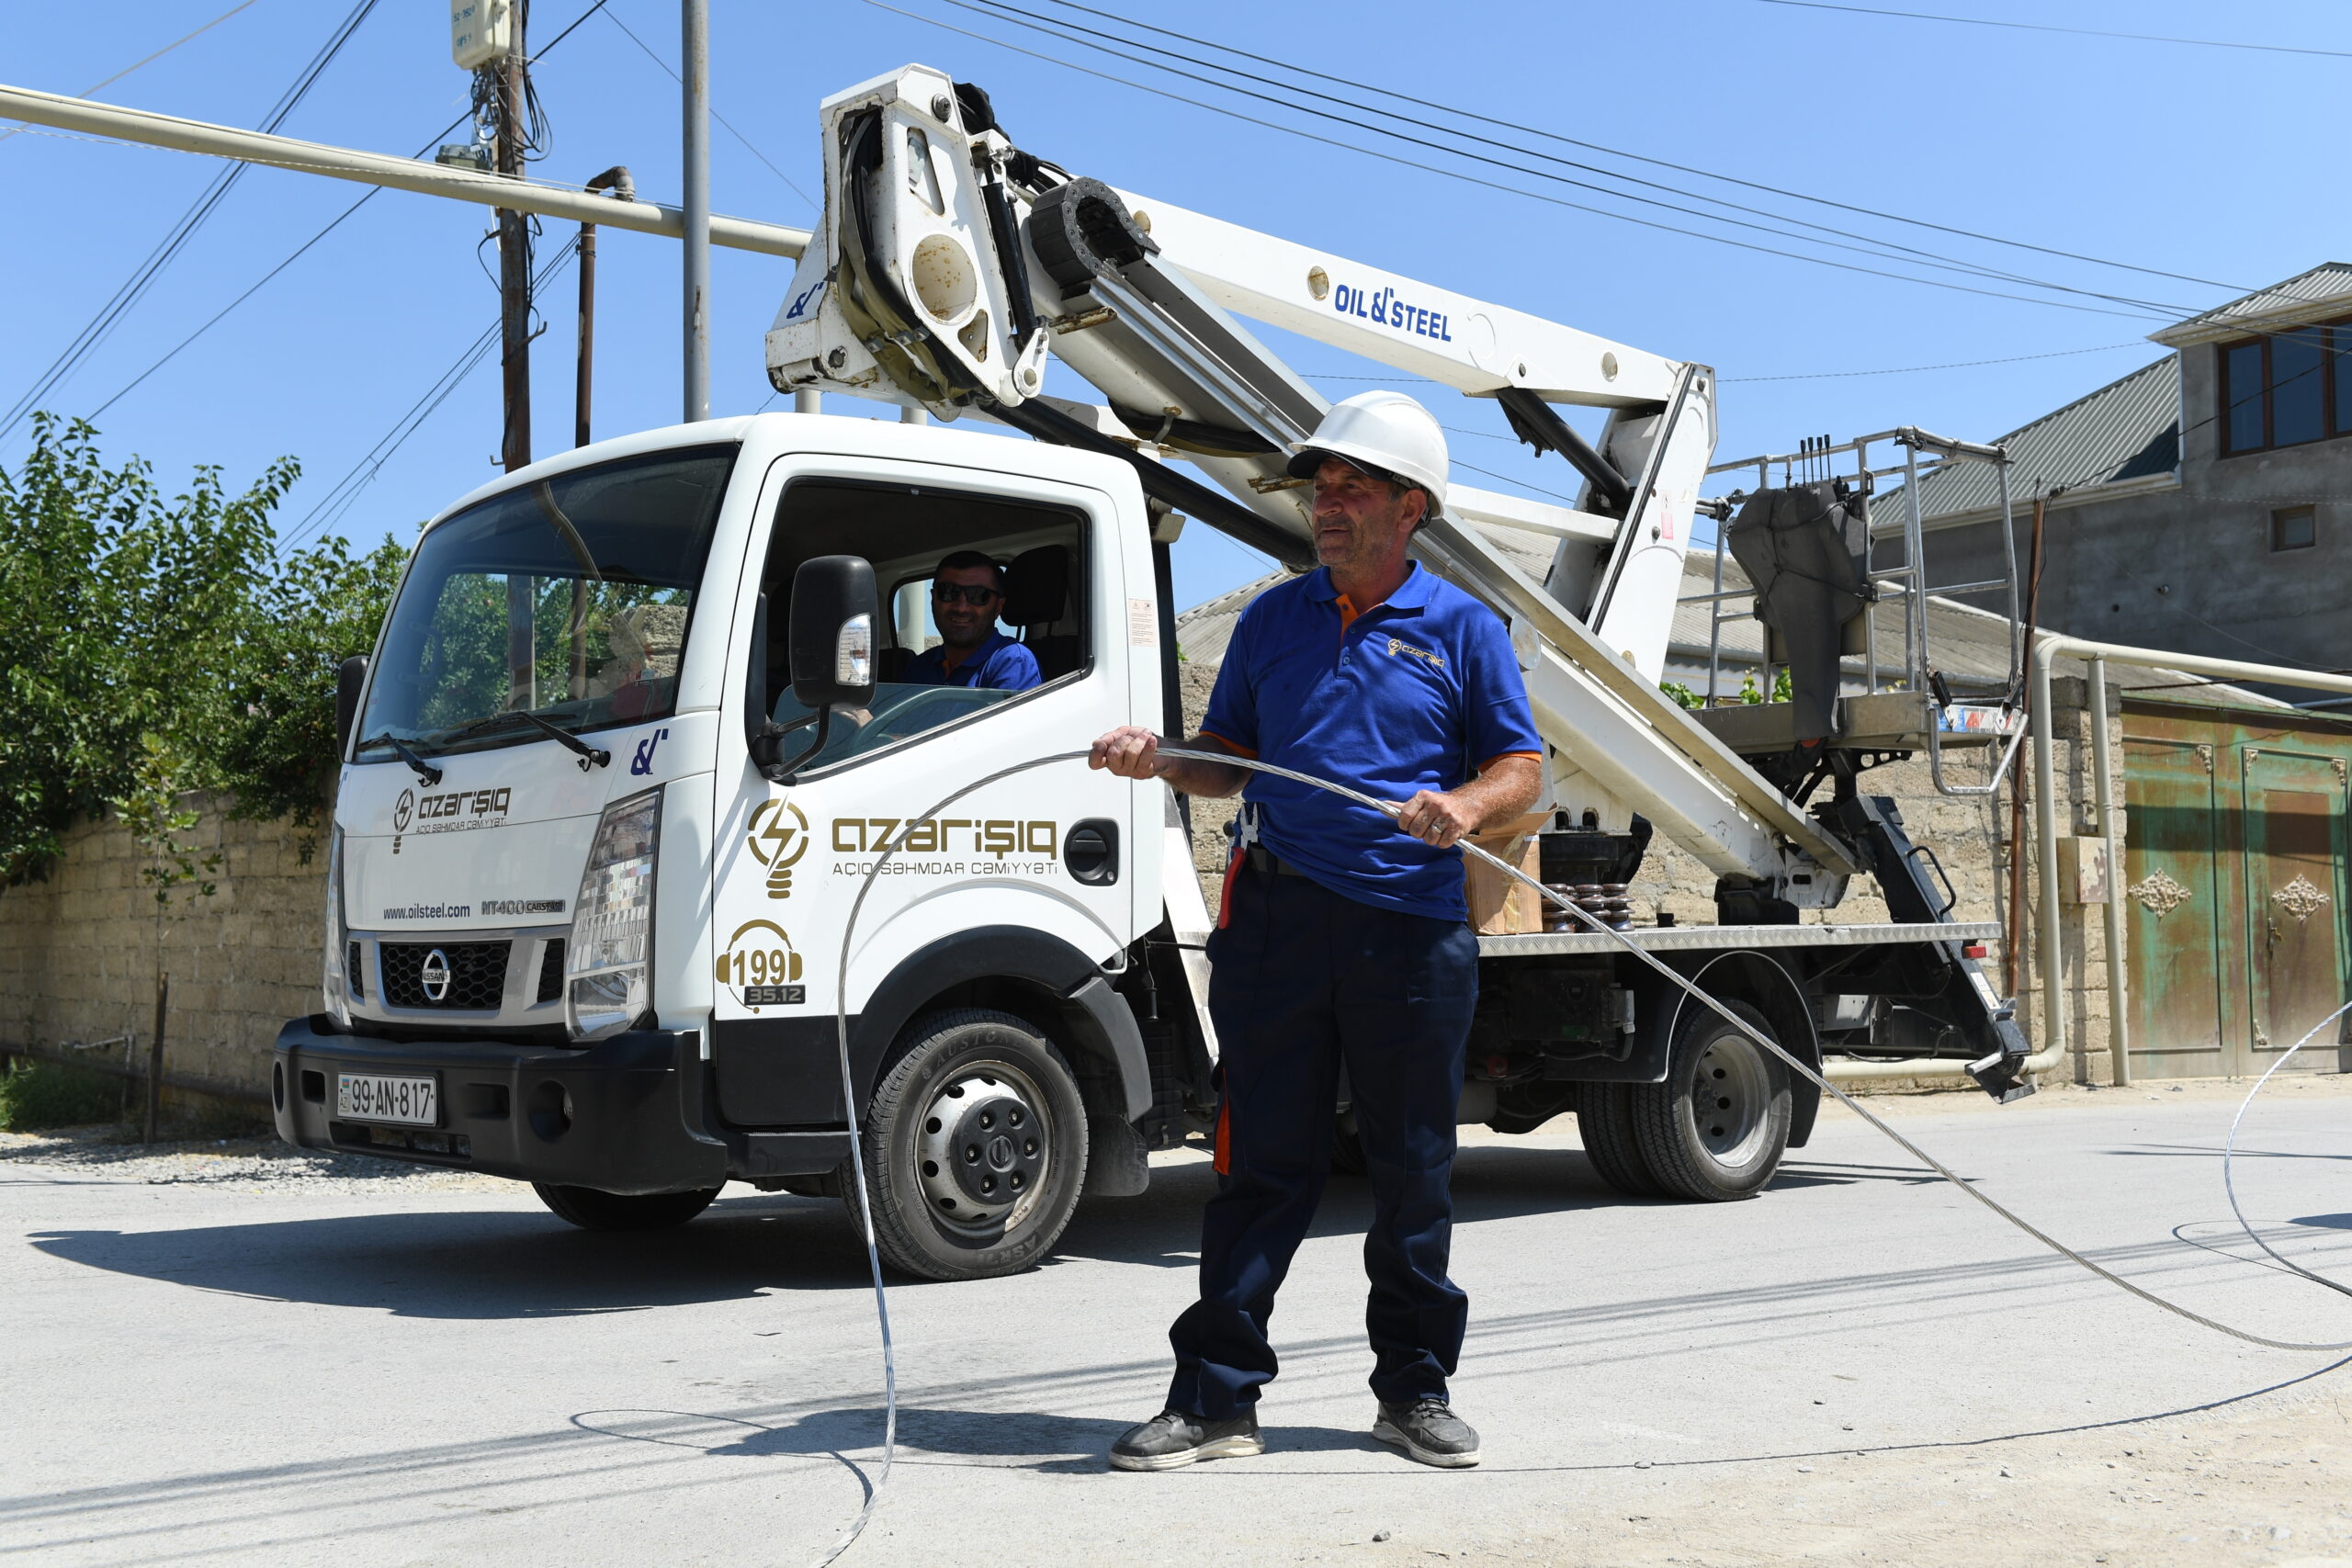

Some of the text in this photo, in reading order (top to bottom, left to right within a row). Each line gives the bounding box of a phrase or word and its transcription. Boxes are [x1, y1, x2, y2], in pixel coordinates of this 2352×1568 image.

[383, 902, 470, 919] www.oilsteel.com
[732, 949, 786, 986] 199
[749, 987, 801, 1002] 35.12
[352, 1078, 431, 1119] 99-AN-817
